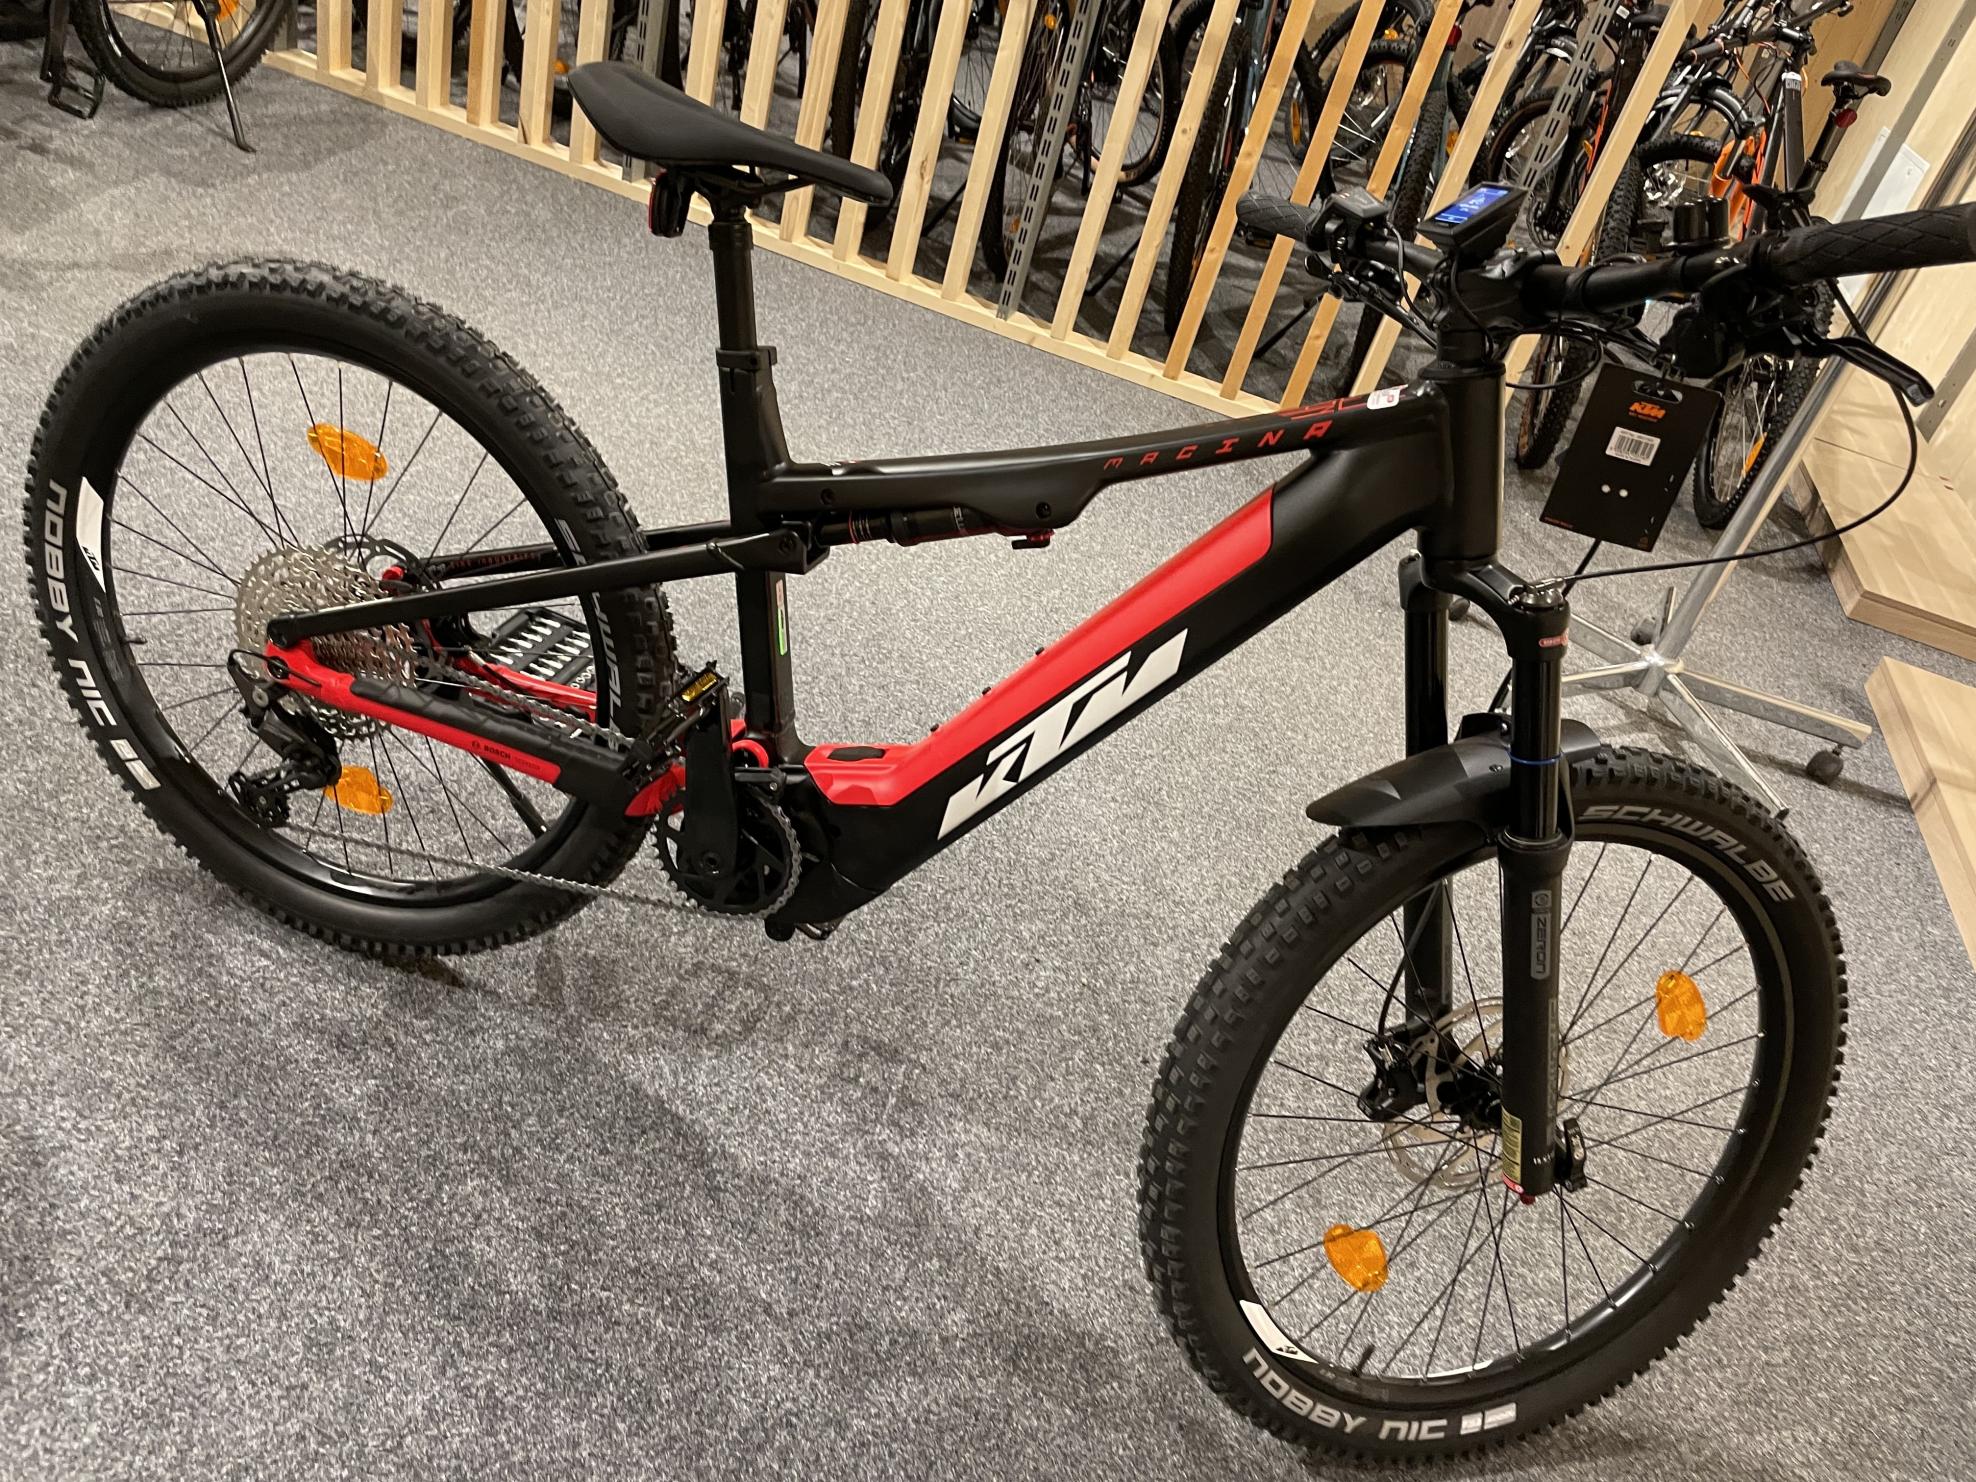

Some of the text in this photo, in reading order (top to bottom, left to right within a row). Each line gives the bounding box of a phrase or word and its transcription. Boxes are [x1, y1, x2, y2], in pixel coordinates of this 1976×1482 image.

[1103, 419, 1333, 471] MACINA
[44, 478, 79, 643] NOBBY
[67, 657, 118, 727] NIC
[483, 744, 512, 761] BOSCH
[937, 628, 1189, 841] KTM
[1578, 805, 1796, 902] SCHWALBE
[1242, 1347, 1367, 1434] NOBBY
[1379, 1418, 1448, 1441] NIC
